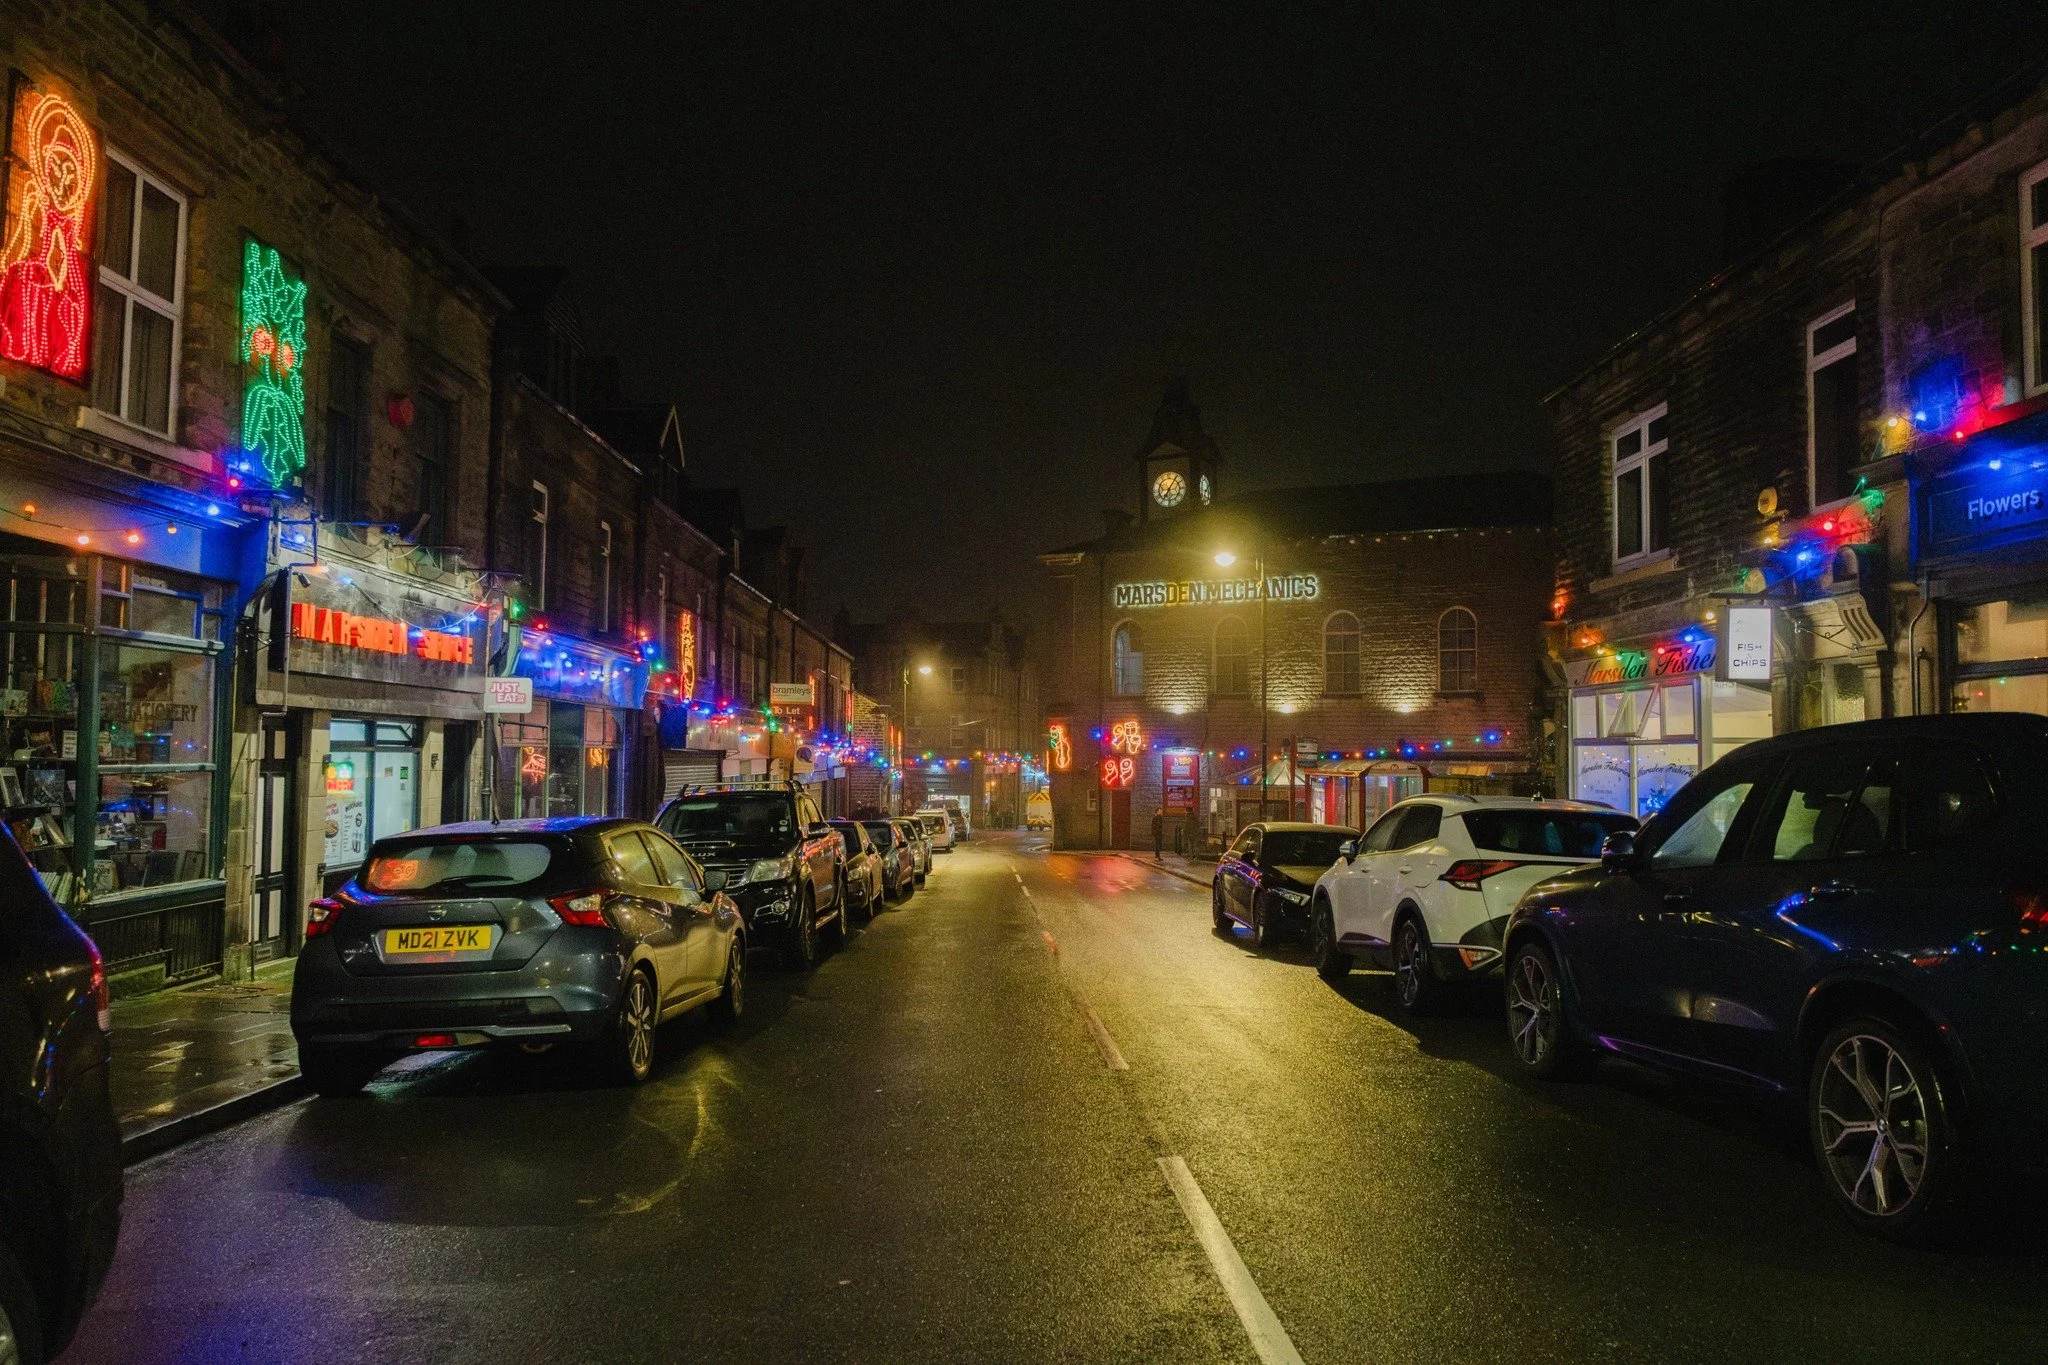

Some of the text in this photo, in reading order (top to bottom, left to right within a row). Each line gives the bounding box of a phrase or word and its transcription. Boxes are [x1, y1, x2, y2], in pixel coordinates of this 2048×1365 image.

[1967, 489, 2040, 520] Flowers
[1116, 575, 1319, 607] MARSDEN MECHANICS
[291, 602, 409, 655] MARSDEN
[1737, 643, 1762, 652] FISH
[1574, 652, 1648, 686] Marsden
[1733, 659, 1767, 668] CHIPS
[490, 682, 519, 694] JUST
[773, 686, 811, 697] bramleys
[496, 692, 518, 704] EAT
[773, 705, 801, 715] To Let
[398, 929, 479, 949] MD21 ZVK
